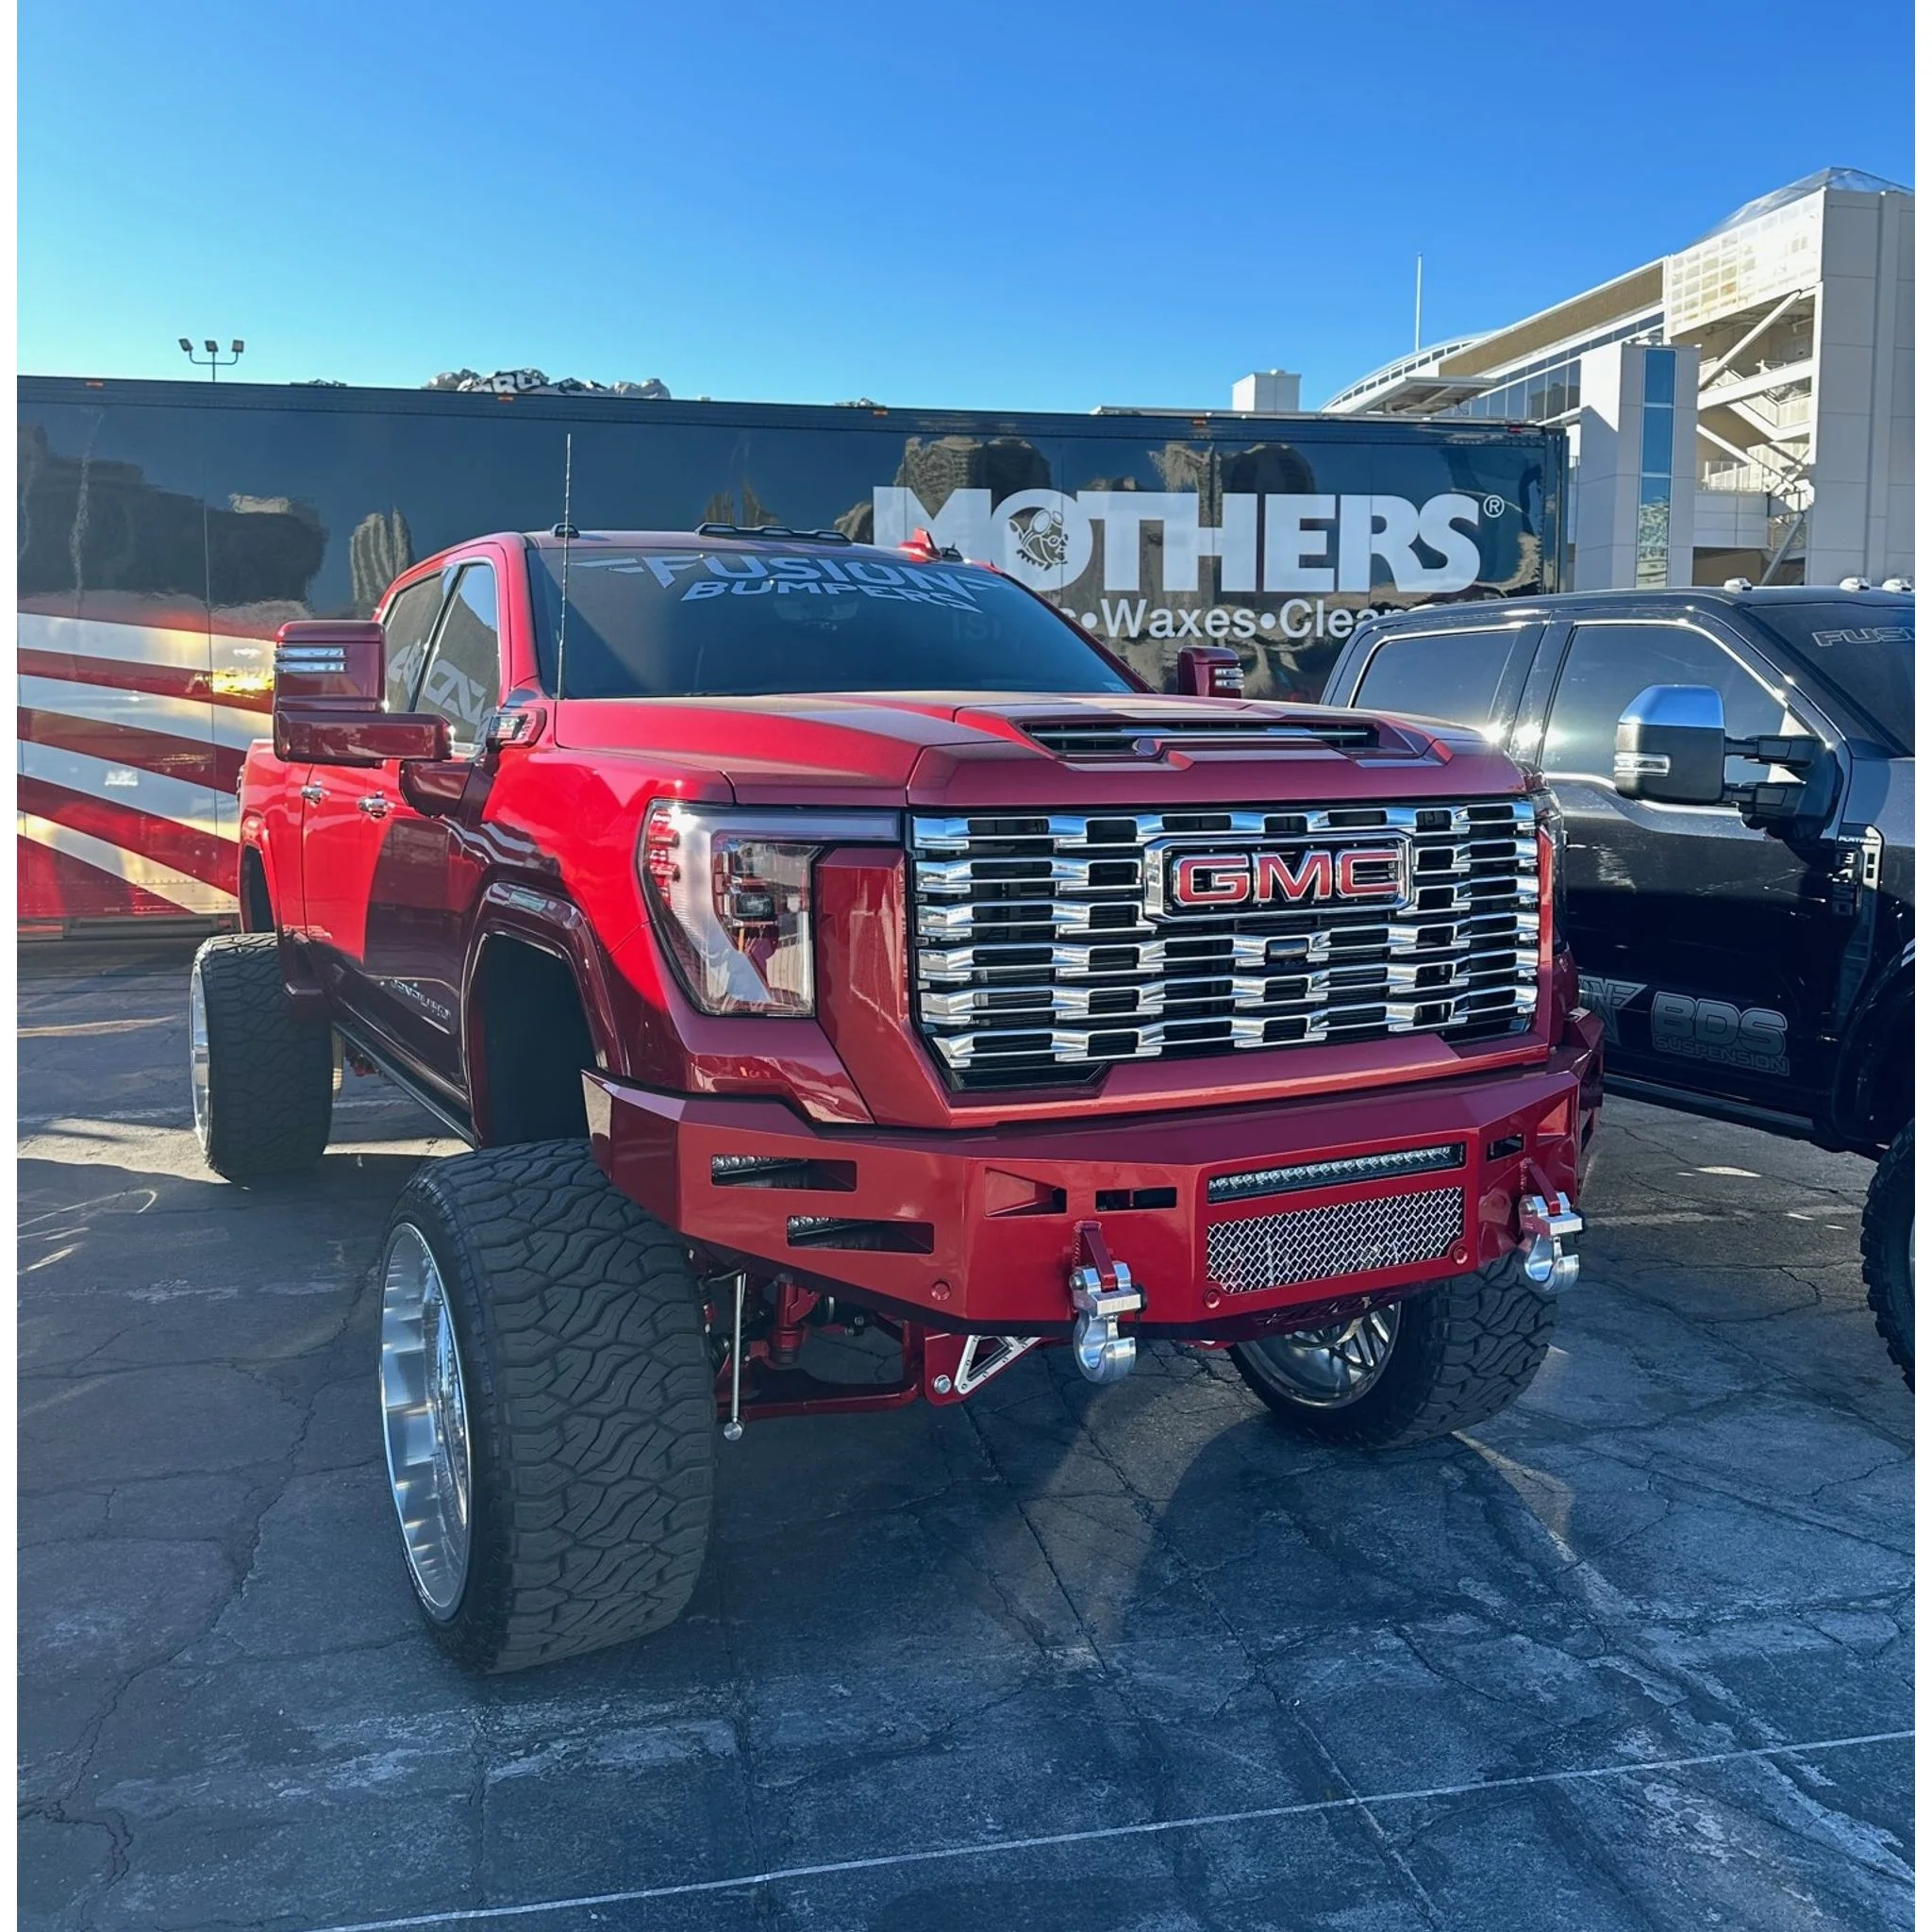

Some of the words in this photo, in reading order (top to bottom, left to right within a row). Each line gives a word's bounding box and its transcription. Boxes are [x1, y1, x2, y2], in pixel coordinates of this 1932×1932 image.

[642, 555, 977, 603] FUSION
[681, 579, 984, 614] BUMPERS
[1811, 626, 1915, 647] FUS
[1173, 850, 1400, 907] GMC
[1651, 991, 1789, 1057] BDS
[1653, 1034, 1790, 1076] SUSPENSION
